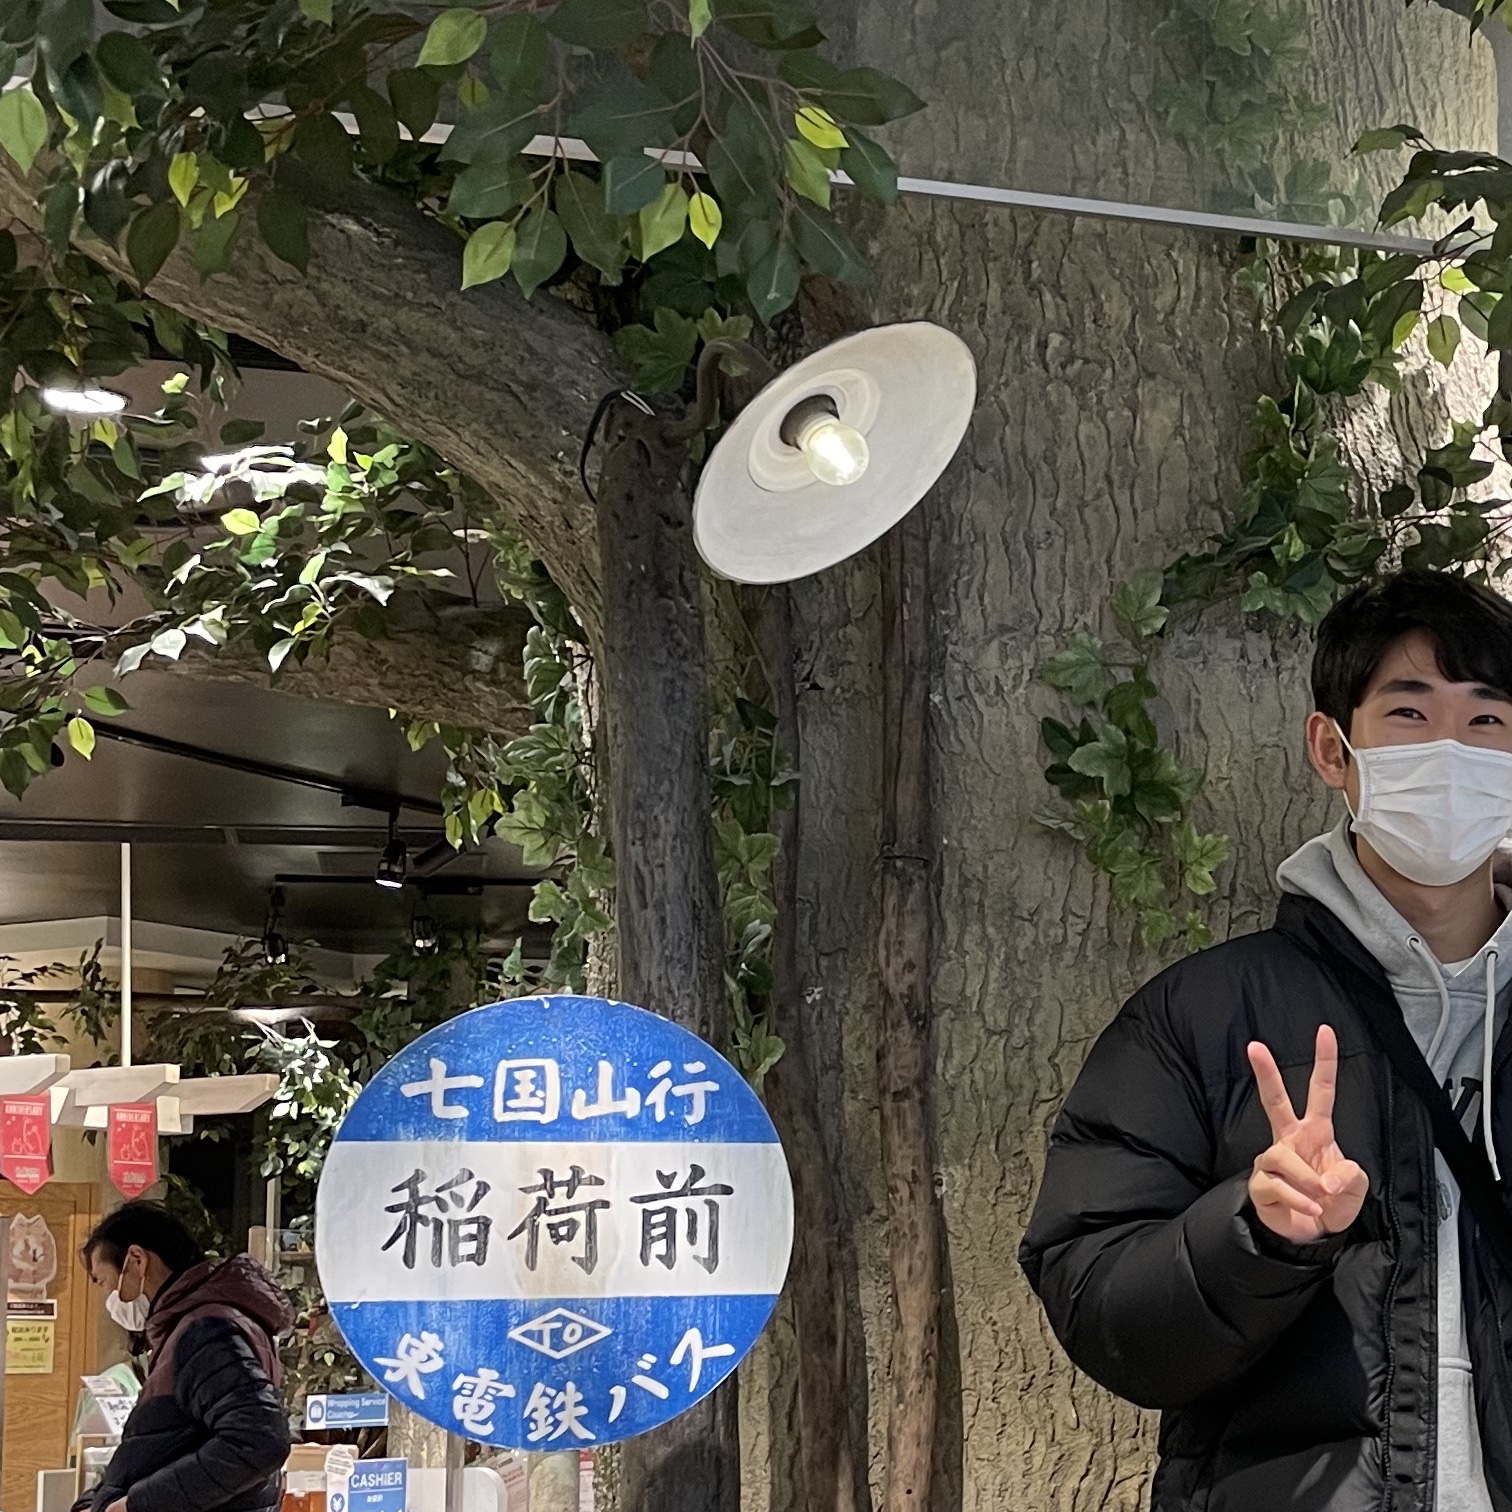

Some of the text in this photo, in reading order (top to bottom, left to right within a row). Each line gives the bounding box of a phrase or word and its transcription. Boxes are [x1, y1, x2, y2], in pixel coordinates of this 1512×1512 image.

[400, 1058, 719, 1125] 七国山行
[381, 1164, 735, 1275] 稲荷前
[361, 1397, 386, 1406] Service
[374, 1327, 735, 1443] 東電鉄バス
[350, 1472, 402, 1488] CASHIER
